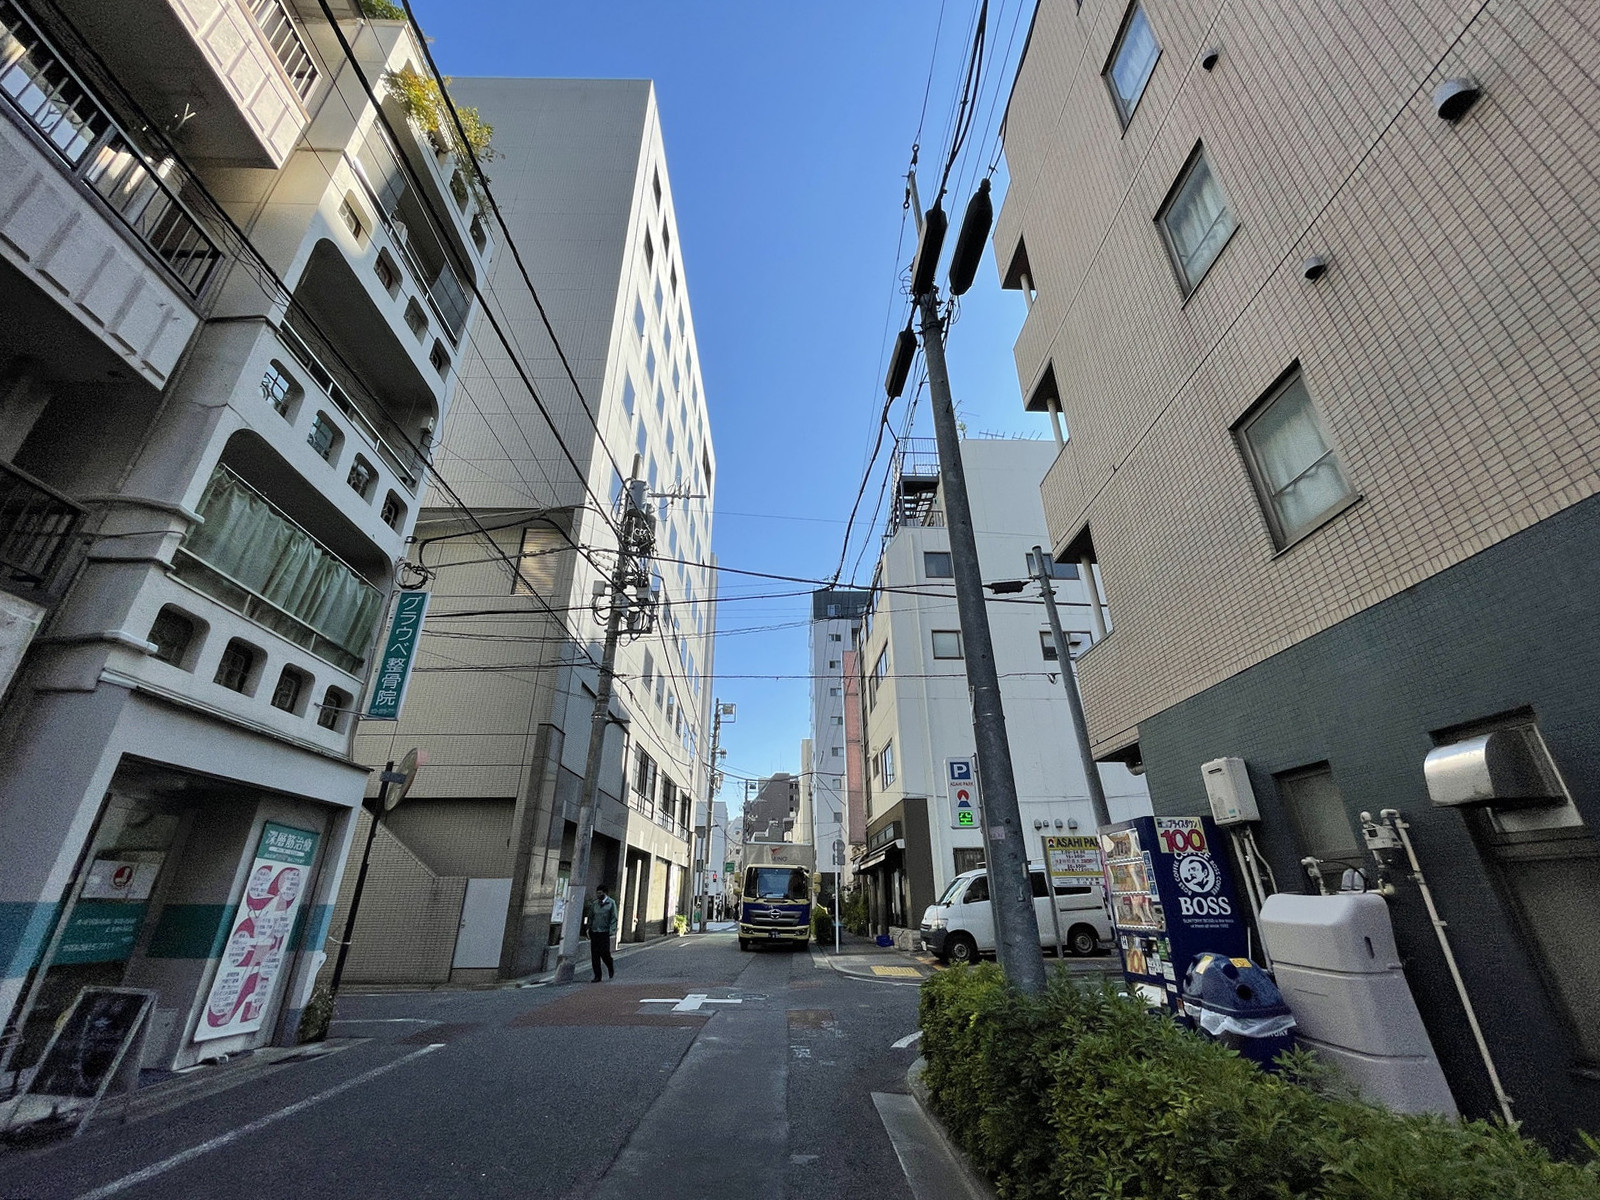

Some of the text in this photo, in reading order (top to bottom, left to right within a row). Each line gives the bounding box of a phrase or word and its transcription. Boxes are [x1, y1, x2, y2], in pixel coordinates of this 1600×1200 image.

[953, 764, 968, 778] P
[265, 830, 312, 852] 深層筋治療
[1056, 837, 1083, 847] ASAHI
[1160, 828, 1206, 852] 100
[1172, 860, 1181, 882] COFFEE
[1178, 896, 1232, 916] BOSS
